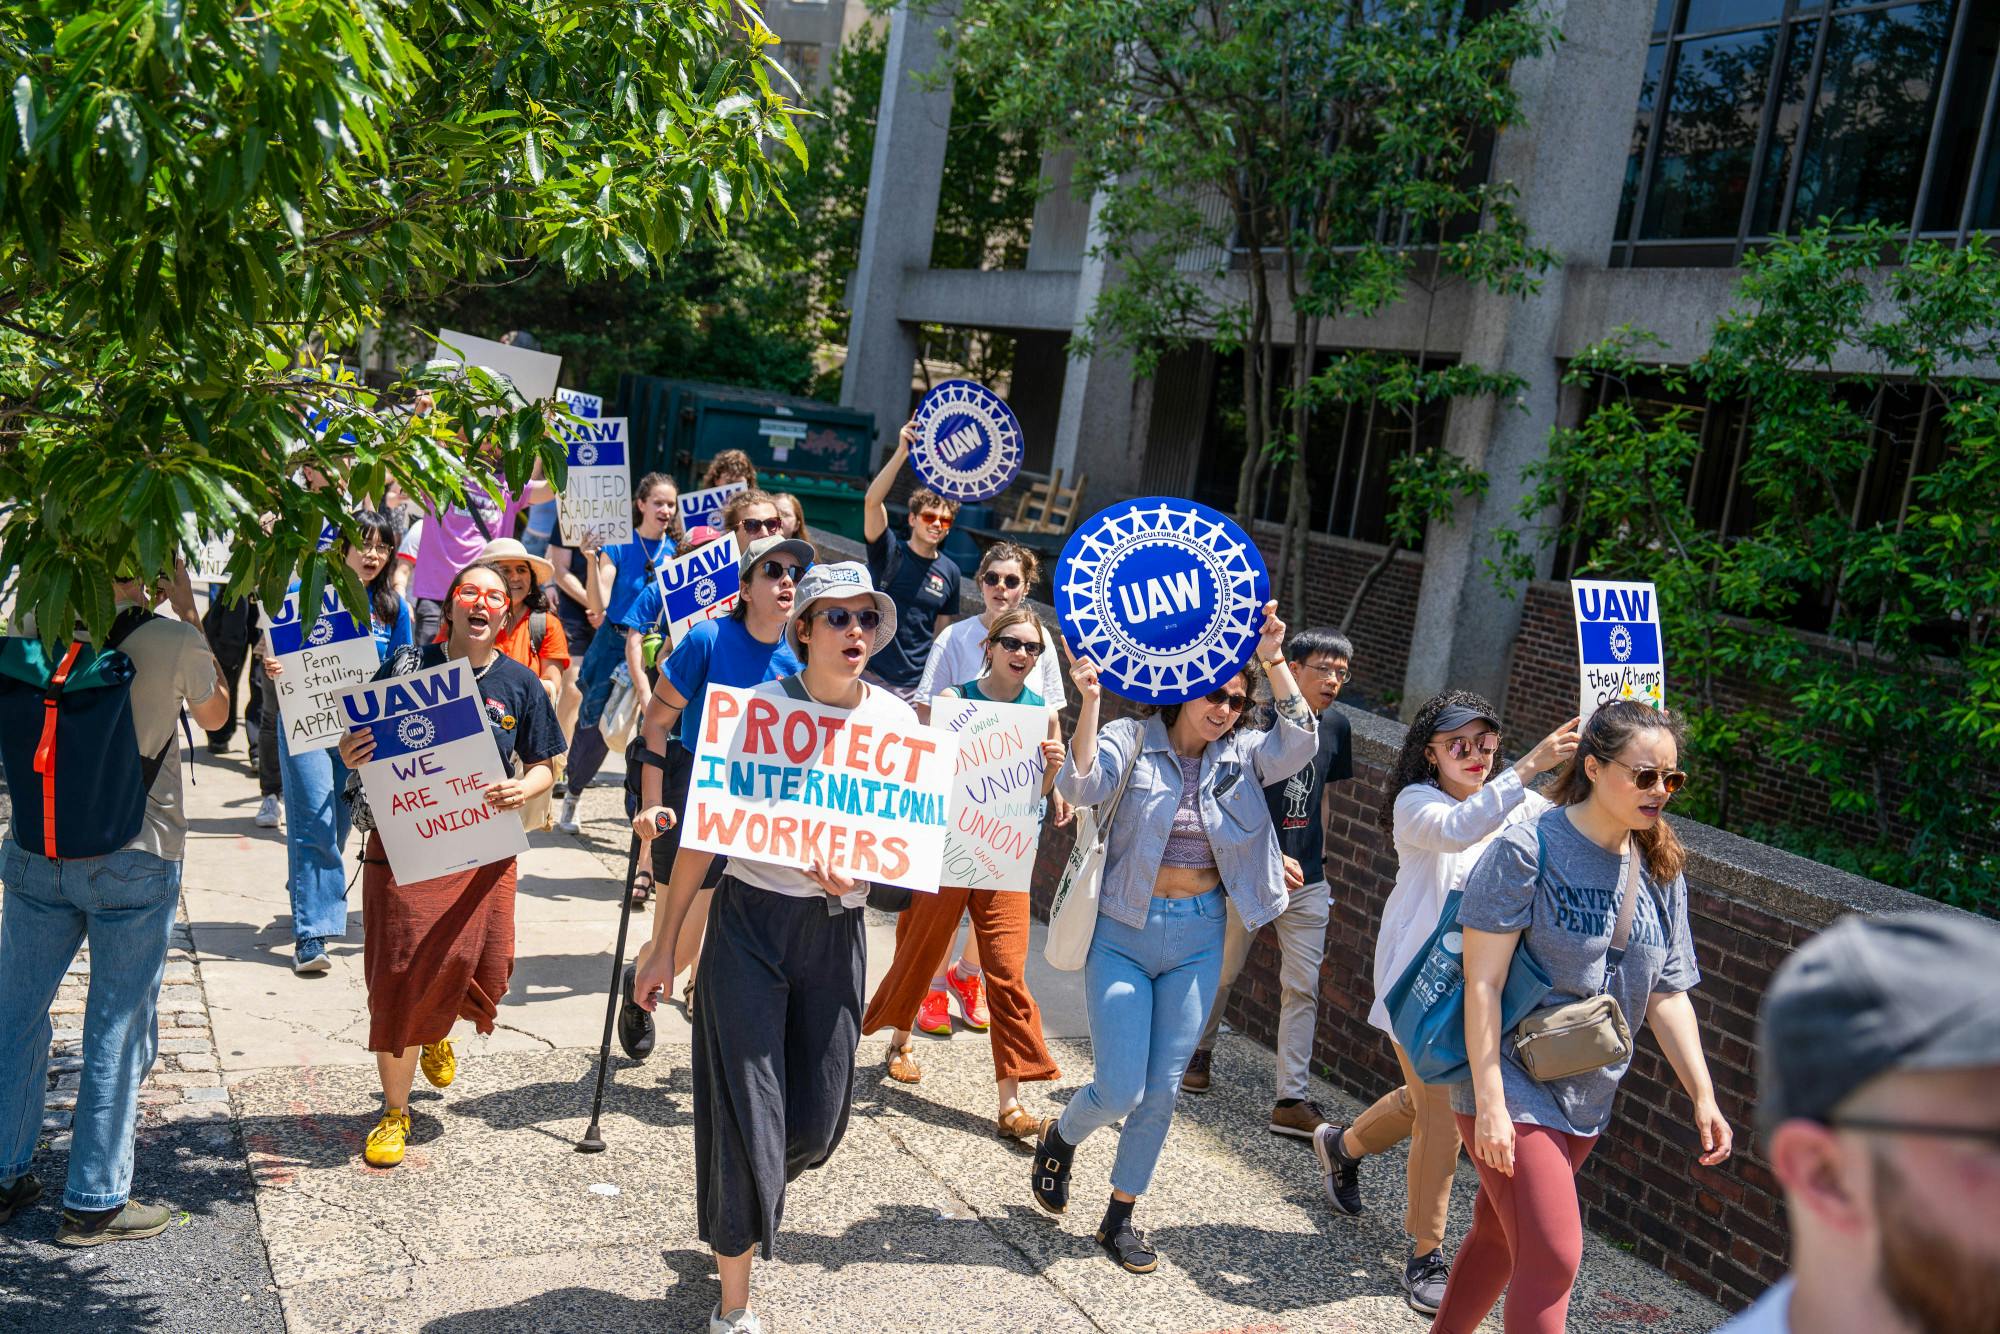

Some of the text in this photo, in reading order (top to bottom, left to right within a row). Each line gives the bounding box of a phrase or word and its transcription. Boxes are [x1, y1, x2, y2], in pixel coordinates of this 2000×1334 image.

[561, 392, 598, 408] UAW
[938, 423, 982, 463] UAW
[565, 475, 626, 498] NITED
[560, 499, 628, 520] ACADEMIC
[662, 540, 731, 591] UAW
[1095, 531, 1231, 662] UNITED AUTOMOBILE, AEROSPACE AND AGRICULTURAL IMPLEMENT WORKERS OF AMERICA
[1118, 568, 1201, 624] UAW
[1578, 588, 1650, 622] UAW
[302, 651, 341, 673] Penn
[280, 682, 294, 696] is
[342, 667, 461, 723] UAW
[407, 725, 424, 737] UAW
[705, 690, 936, 784] PROTECT
[970, 713, 999, 735] UNION
[391, 752, 446, 781] WE
[966, 746, 1044, 804] UNION
[392, 772, 490, 816] ARE THE
[697, 755, 948, 827] INTERNATIONAL
[993, 802, 1039, 819] UNION
[697, 802, 911, 881] WORKERS
[958, 806, 1033, 861] UNION
[943, 832, 990, 887] NION
[974, 846, 1005, 880] UNION
